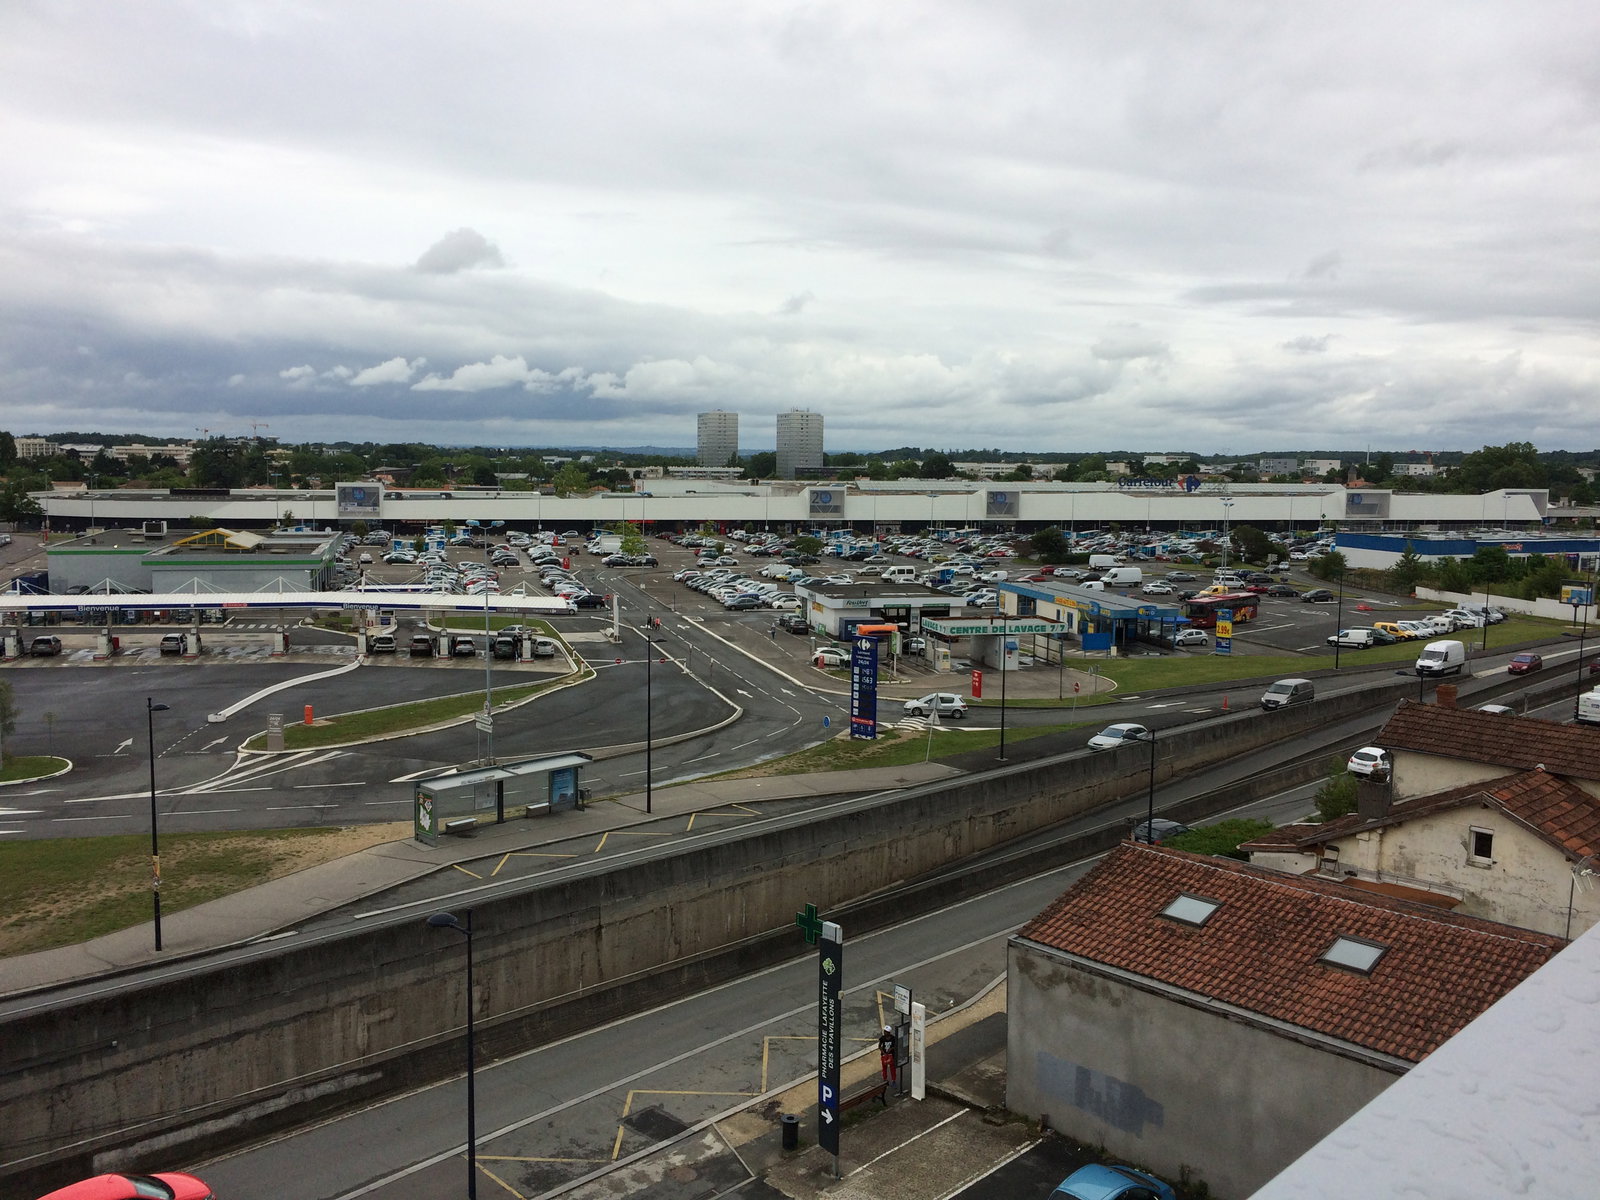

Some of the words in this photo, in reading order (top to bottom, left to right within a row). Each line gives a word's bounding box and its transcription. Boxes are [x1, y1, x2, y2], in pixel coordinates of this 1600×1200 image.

[1118, 475, 1174, 487] Carrefour
[949, 626, 988, 634] CENTRE
[991, 626, 1006, 634] DE
[1050, 624, 1066, 632] 7/7
[822, 1085, 833, 1102] P
